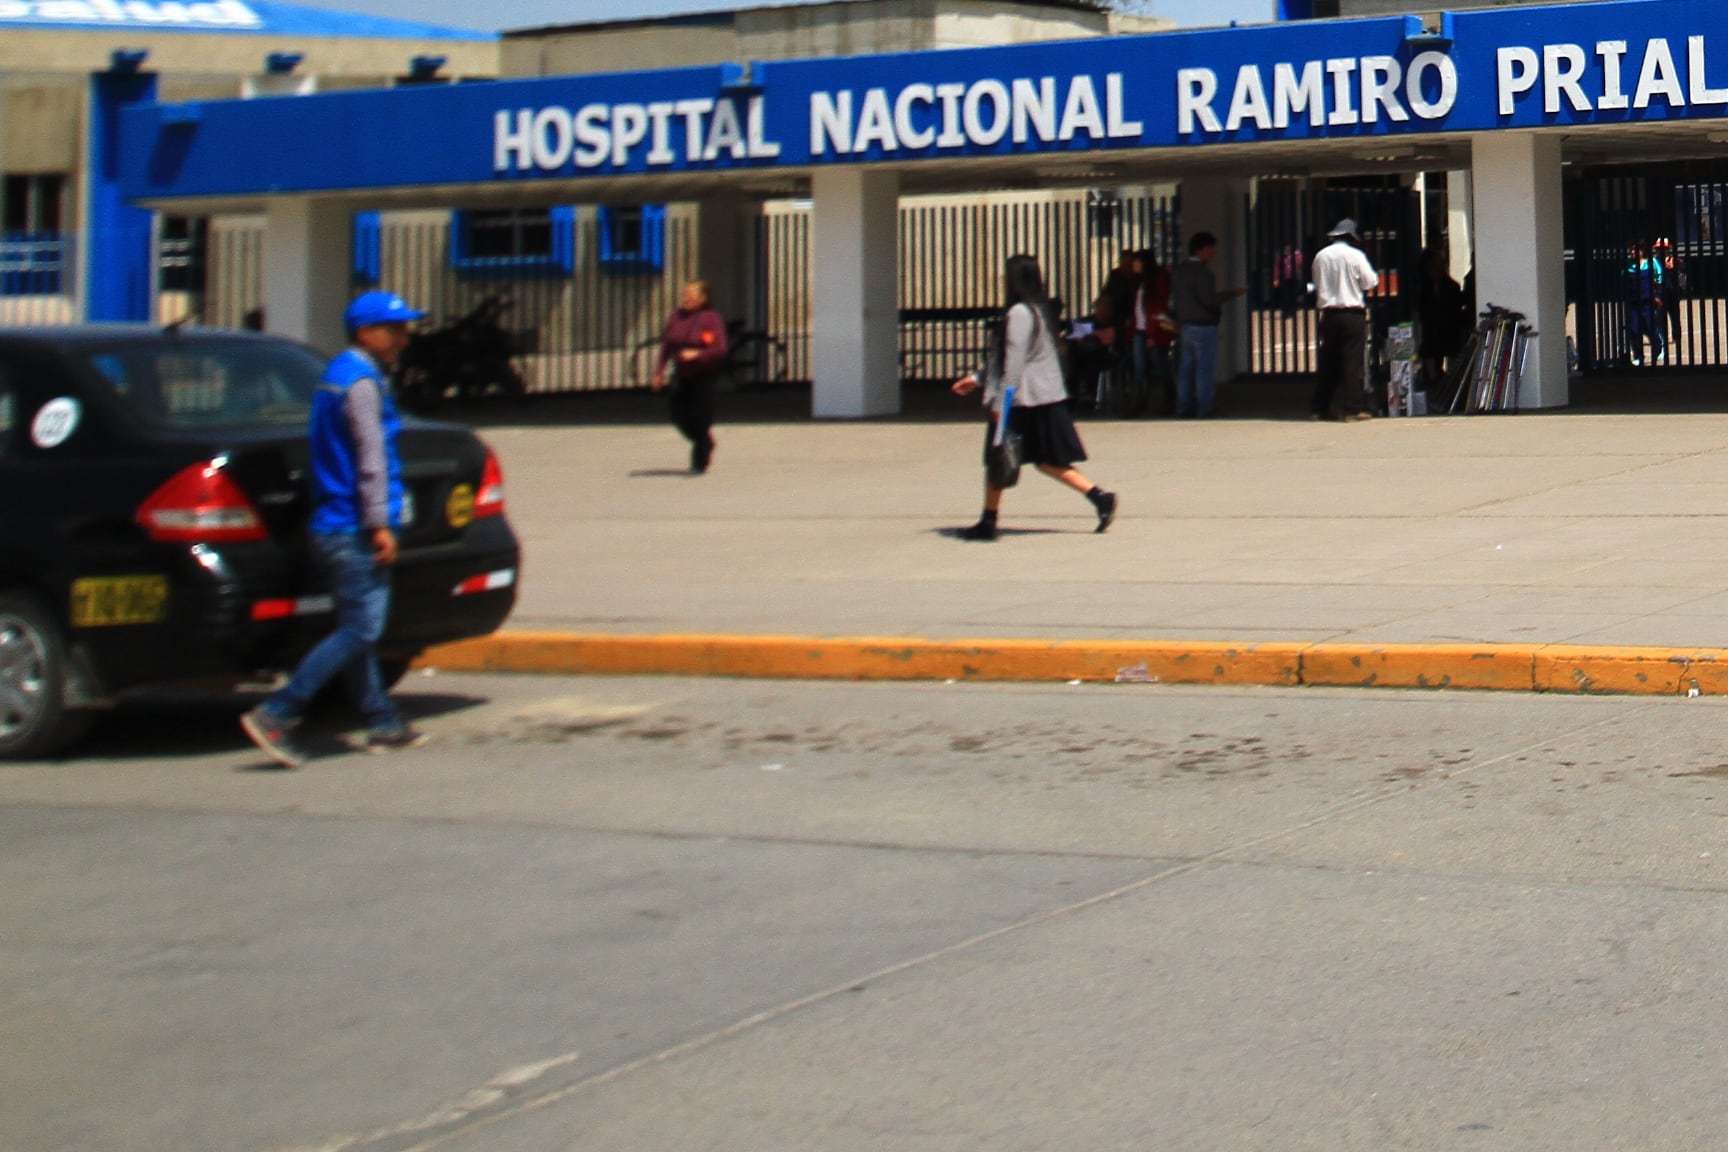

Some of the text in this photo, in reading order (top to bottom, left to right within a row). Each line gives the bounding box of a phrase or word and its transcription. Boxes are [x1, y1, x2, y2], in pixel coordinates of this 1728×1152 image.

[494, 97, 780, 169] HOSPITAL
[810, 73, 1142, 154] NACIONAL
[1177, 51, 1457, 133] RAMIRO
